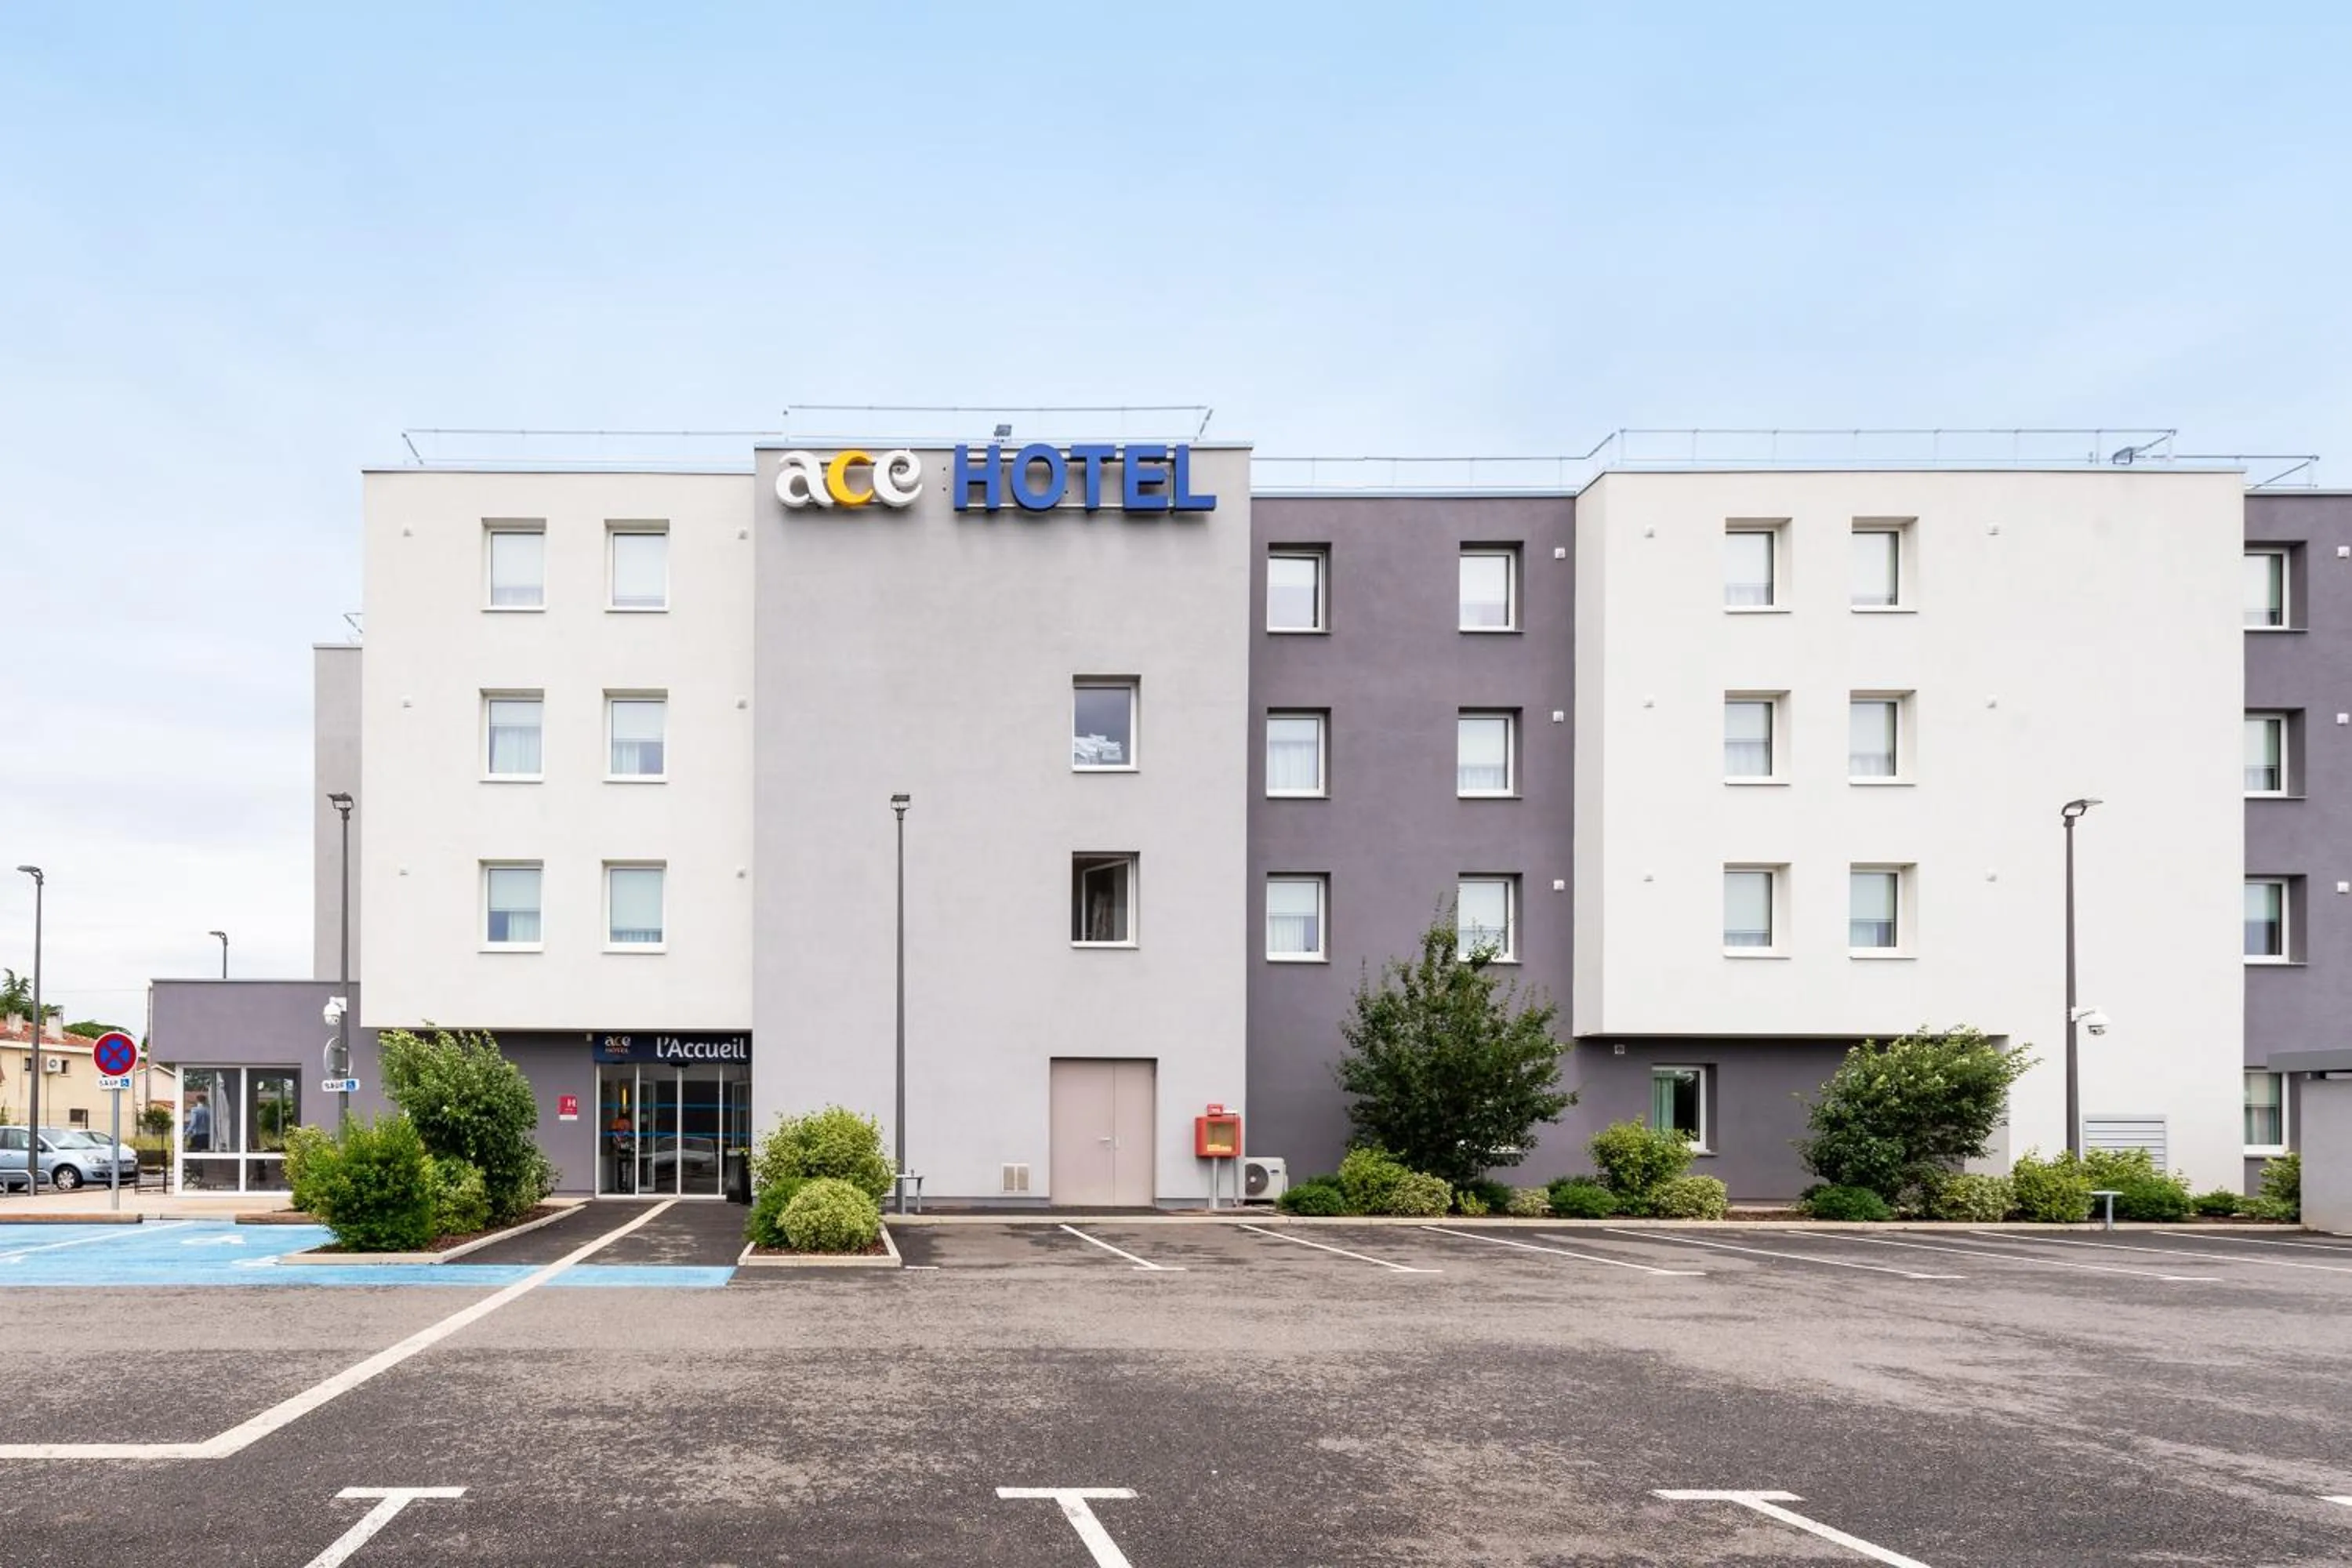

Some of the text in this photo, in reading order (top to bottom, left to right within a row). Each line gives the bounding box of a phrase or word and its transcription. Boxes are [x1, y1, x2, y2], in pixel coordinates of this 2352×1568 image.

[775, 443, 1217, 512] ace HOTEL
[604, 1035, 630, 1046] ace
[656, 1036, 746, 1058] l'Accueil
